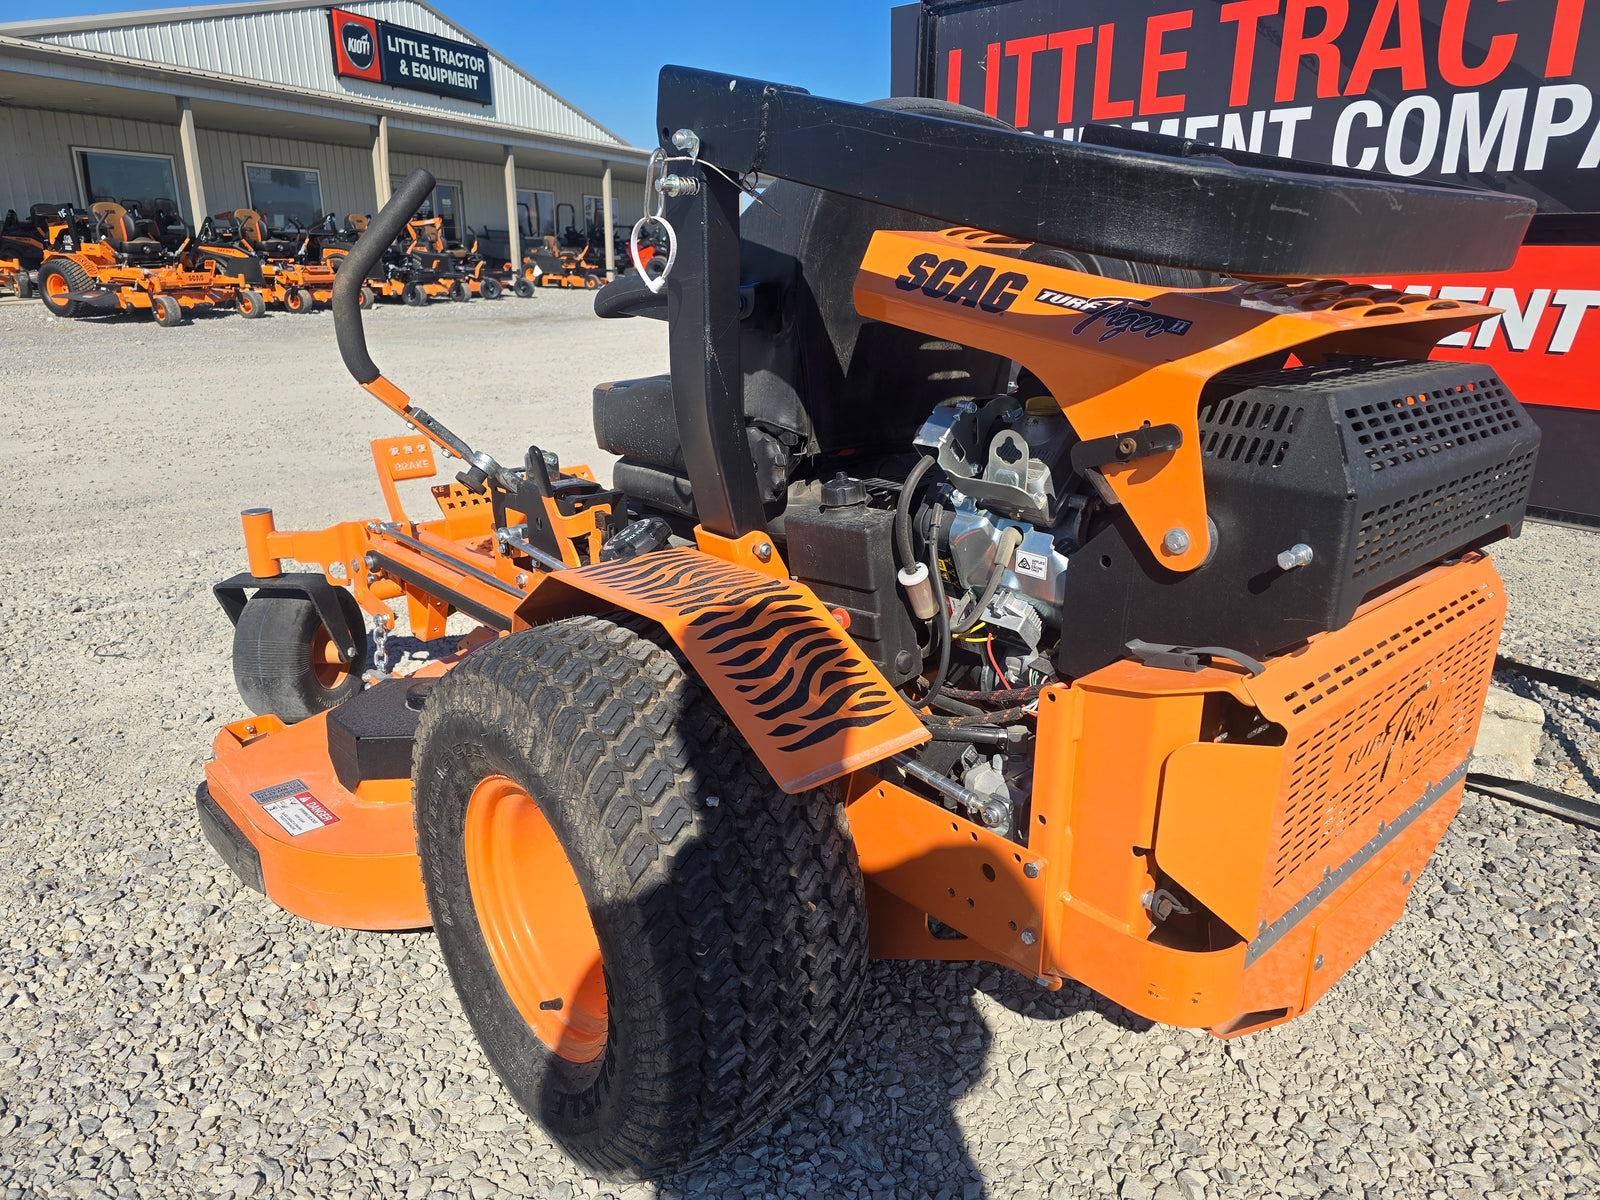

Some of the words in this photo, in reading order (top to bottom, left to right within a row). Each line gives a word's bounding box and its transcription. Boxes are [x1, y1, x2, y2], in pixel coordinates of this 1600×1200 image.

[387, 35, 430, 60] LITTLE
[432, 46, 486, 73] TRACTOR
[399, 59, 409, 76] &
[411, 61, 479, 90] EQUIPMENT
[895, 252, 1029, 314] SCAG
[1036, 290, 1103, 311] TURF
[1072, 296, 1165, 343] Tiger
[394, 459, 430, 472] BRAKE
[305, 801, 333, 822] DANGER
